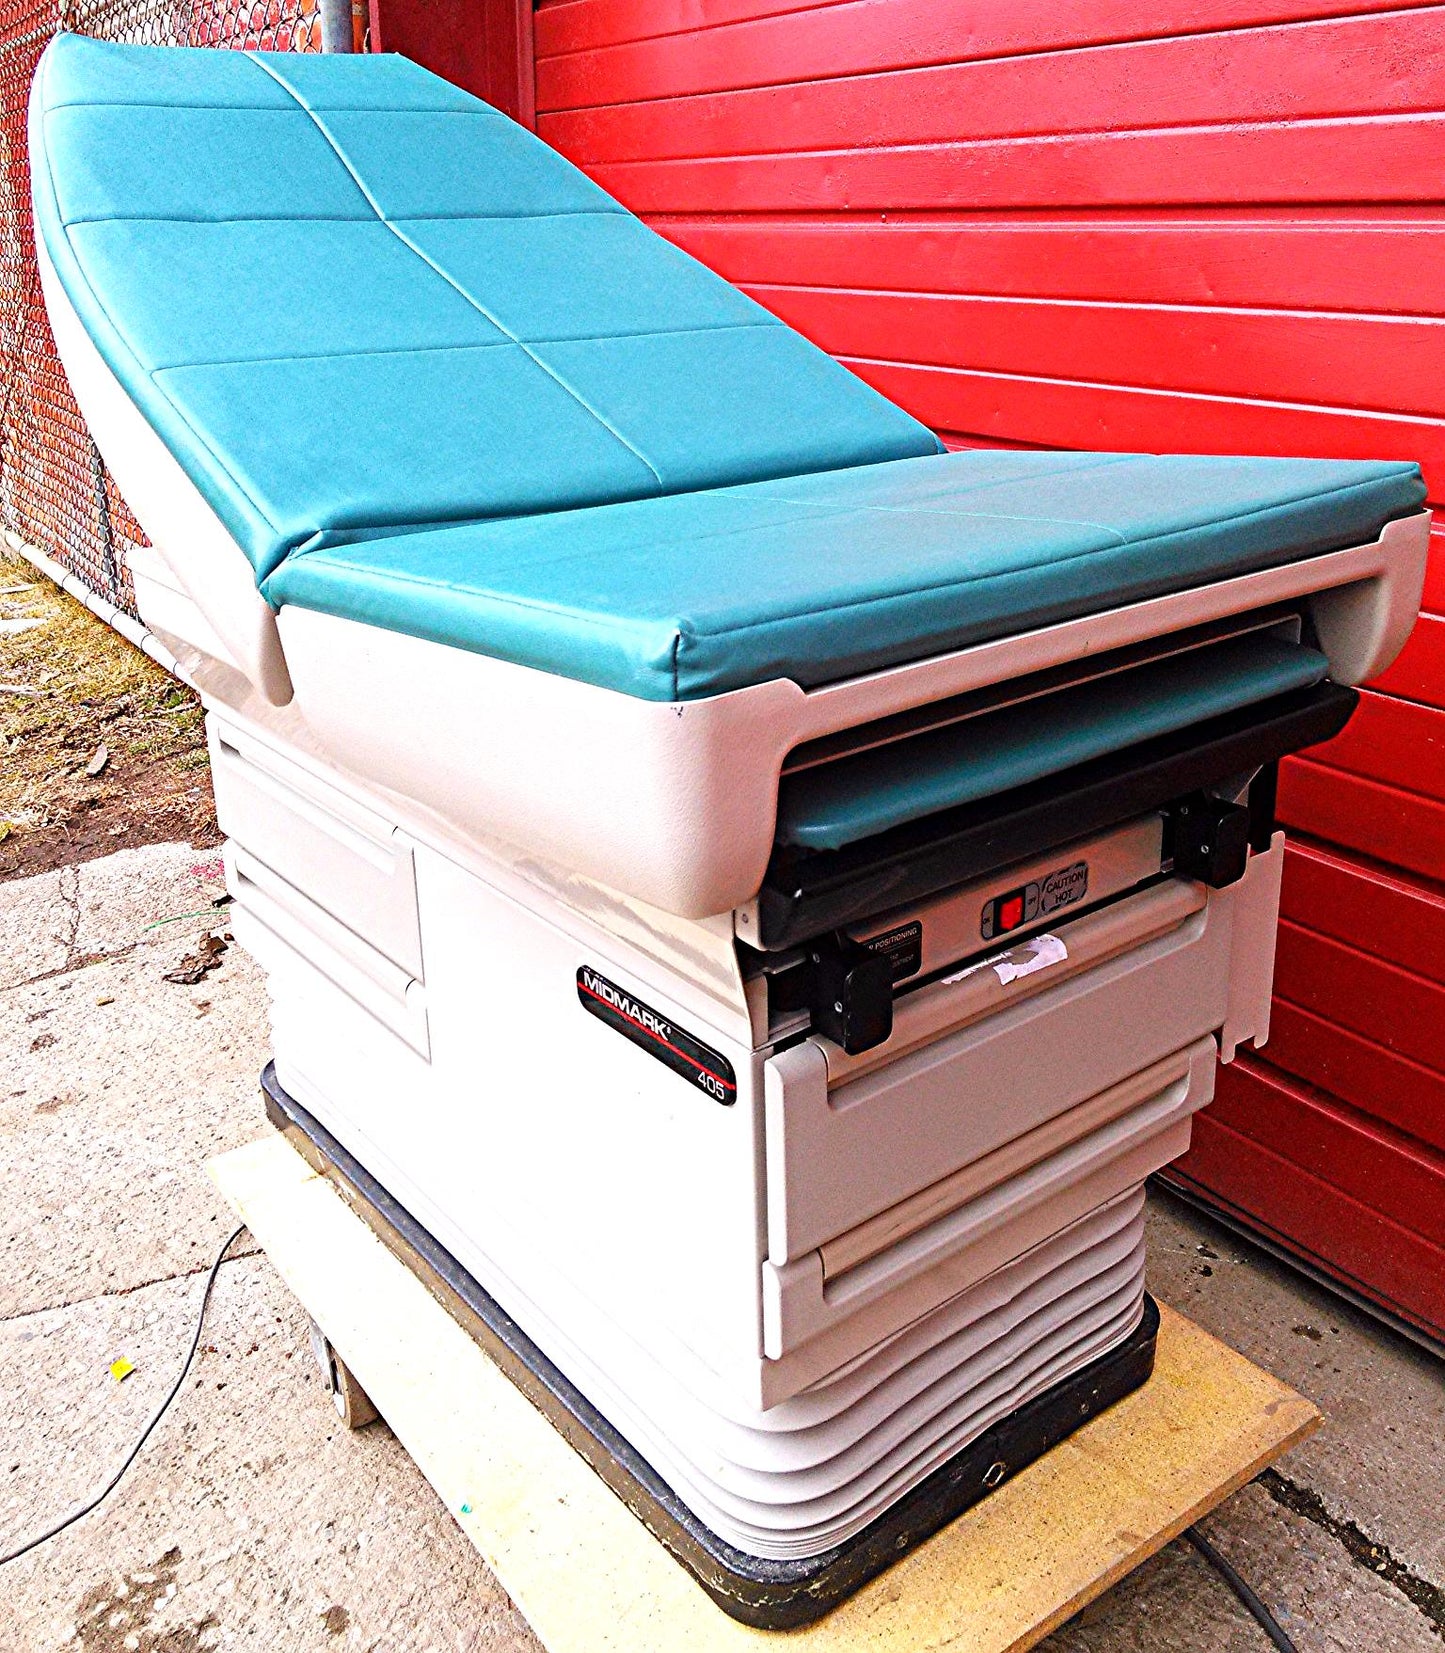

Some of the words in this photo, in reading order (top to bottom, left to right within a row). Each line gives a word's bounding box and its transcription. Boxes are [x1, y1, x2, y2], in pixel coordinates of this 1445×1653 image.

[1046, 870, 1084, 894] CAUTION
[1055, 888, 1074, 904] HOT
[874, 927, 918, 951] POSITIONING
[583, 971, 669, 1041] MIDMARK
[697, 1071, 725, 1100] 405
